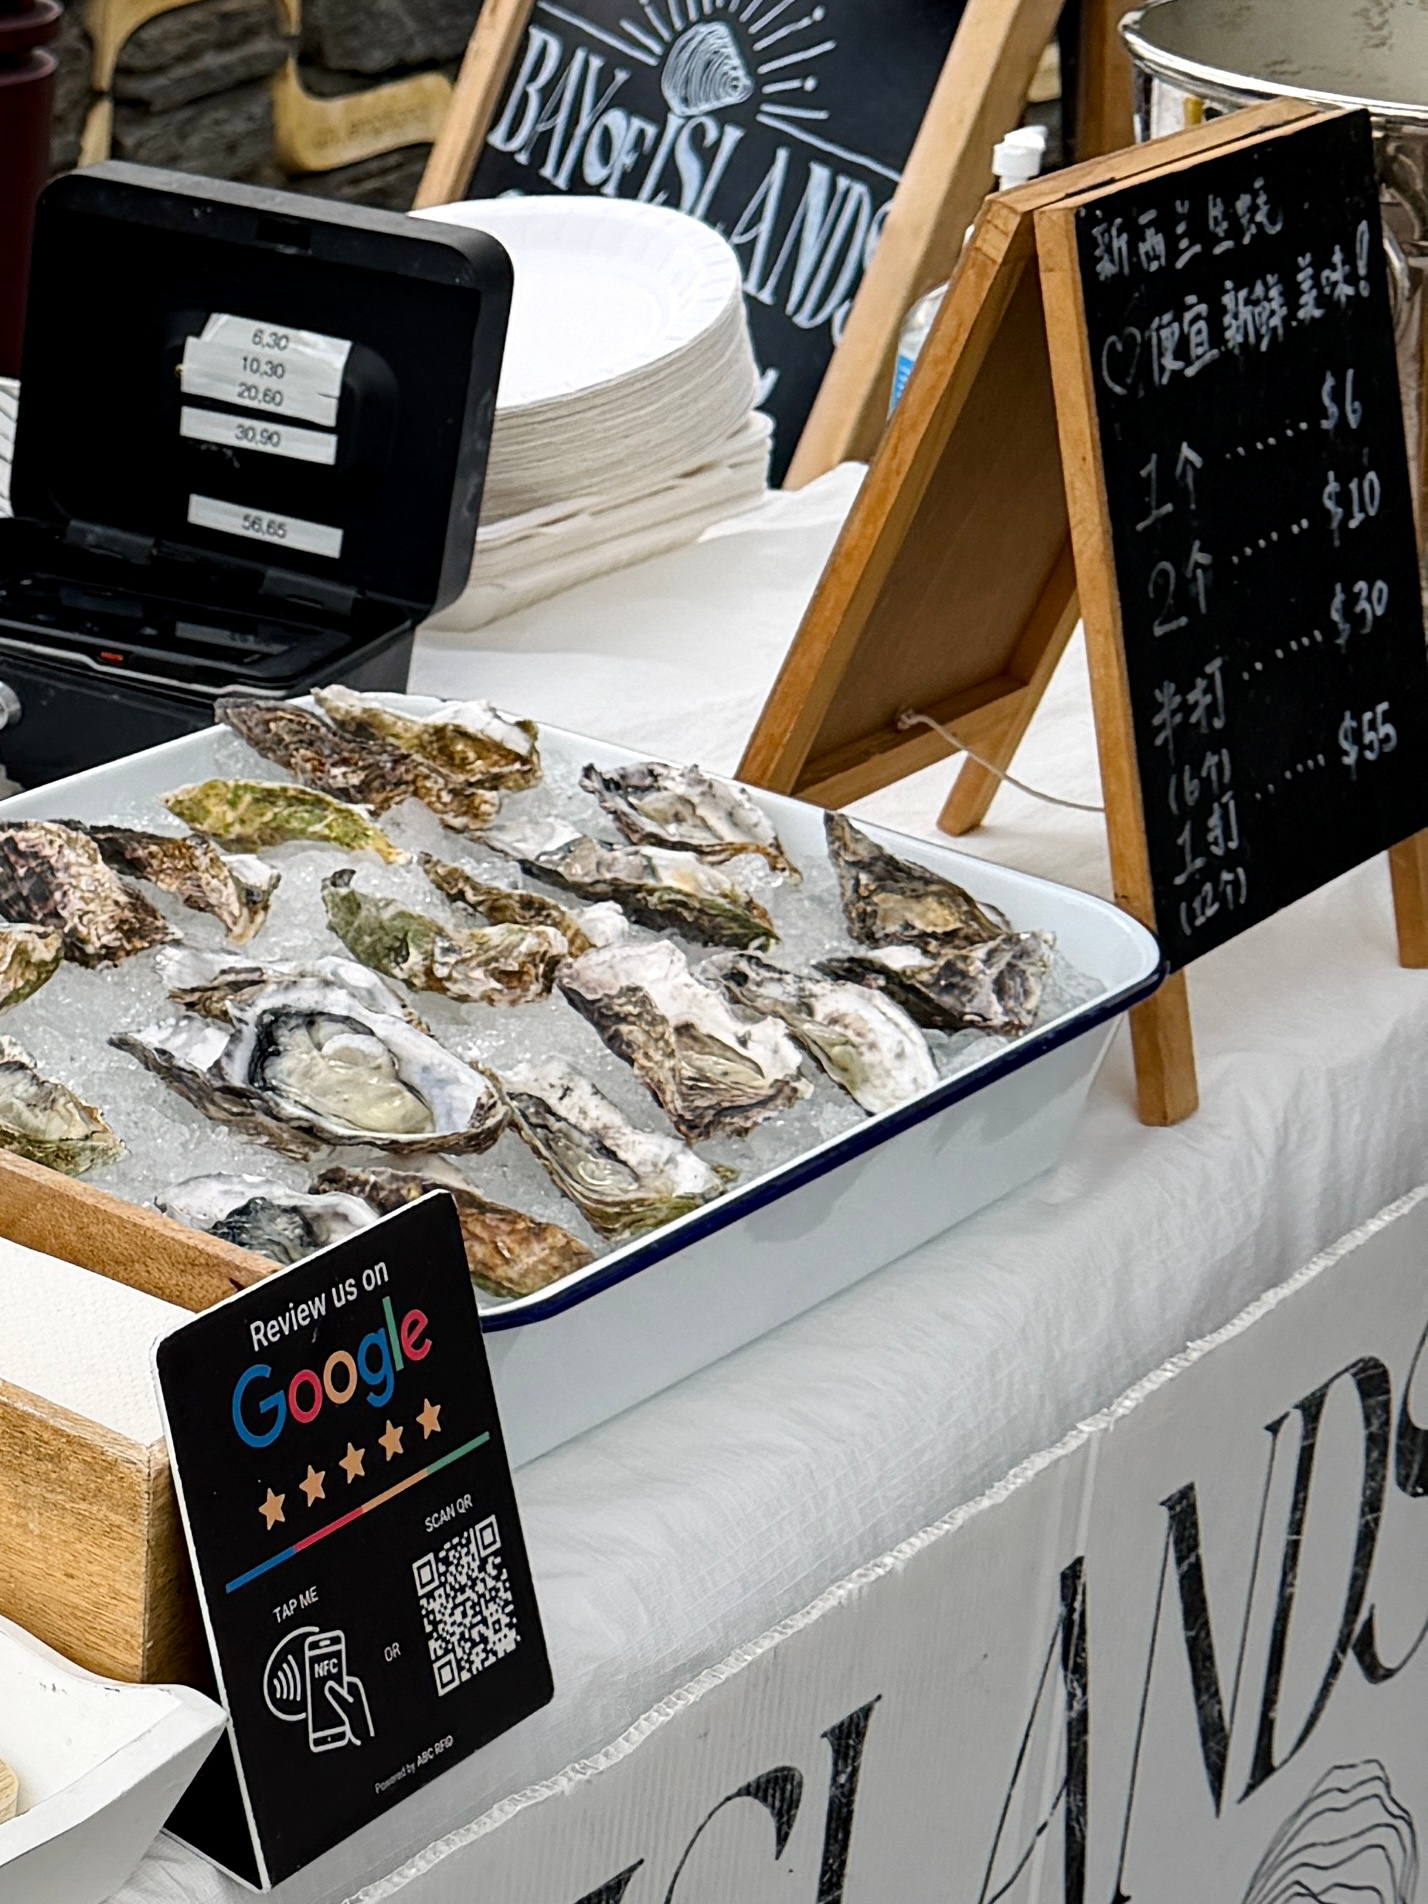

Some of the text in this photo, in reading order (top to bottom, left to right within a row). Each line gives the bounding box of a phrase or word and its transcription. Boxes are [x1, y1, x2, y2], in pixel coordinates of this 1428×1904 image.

[487, 24, 631, 191] BAY
[583, 107, 659, 196] OF
[1320, 368, 1362, 431] $6
[1323, 470, 1381, 547] $10
[1330, 580, 1388, 652] $30
[1338, 701, 1397, 781] $55
[250, 1262, 389, 1352] Review us on
[232, 1296, 433, 1448] Google
[425, 1494, 473, 1532] SCAN QR
[272, 1586, 319, 1623] TAP ME
[314, 1658, 339, 1678] NFC
[384, 1642, 401, 1662] OR
[417, 1747, 434, 1767] ABC
